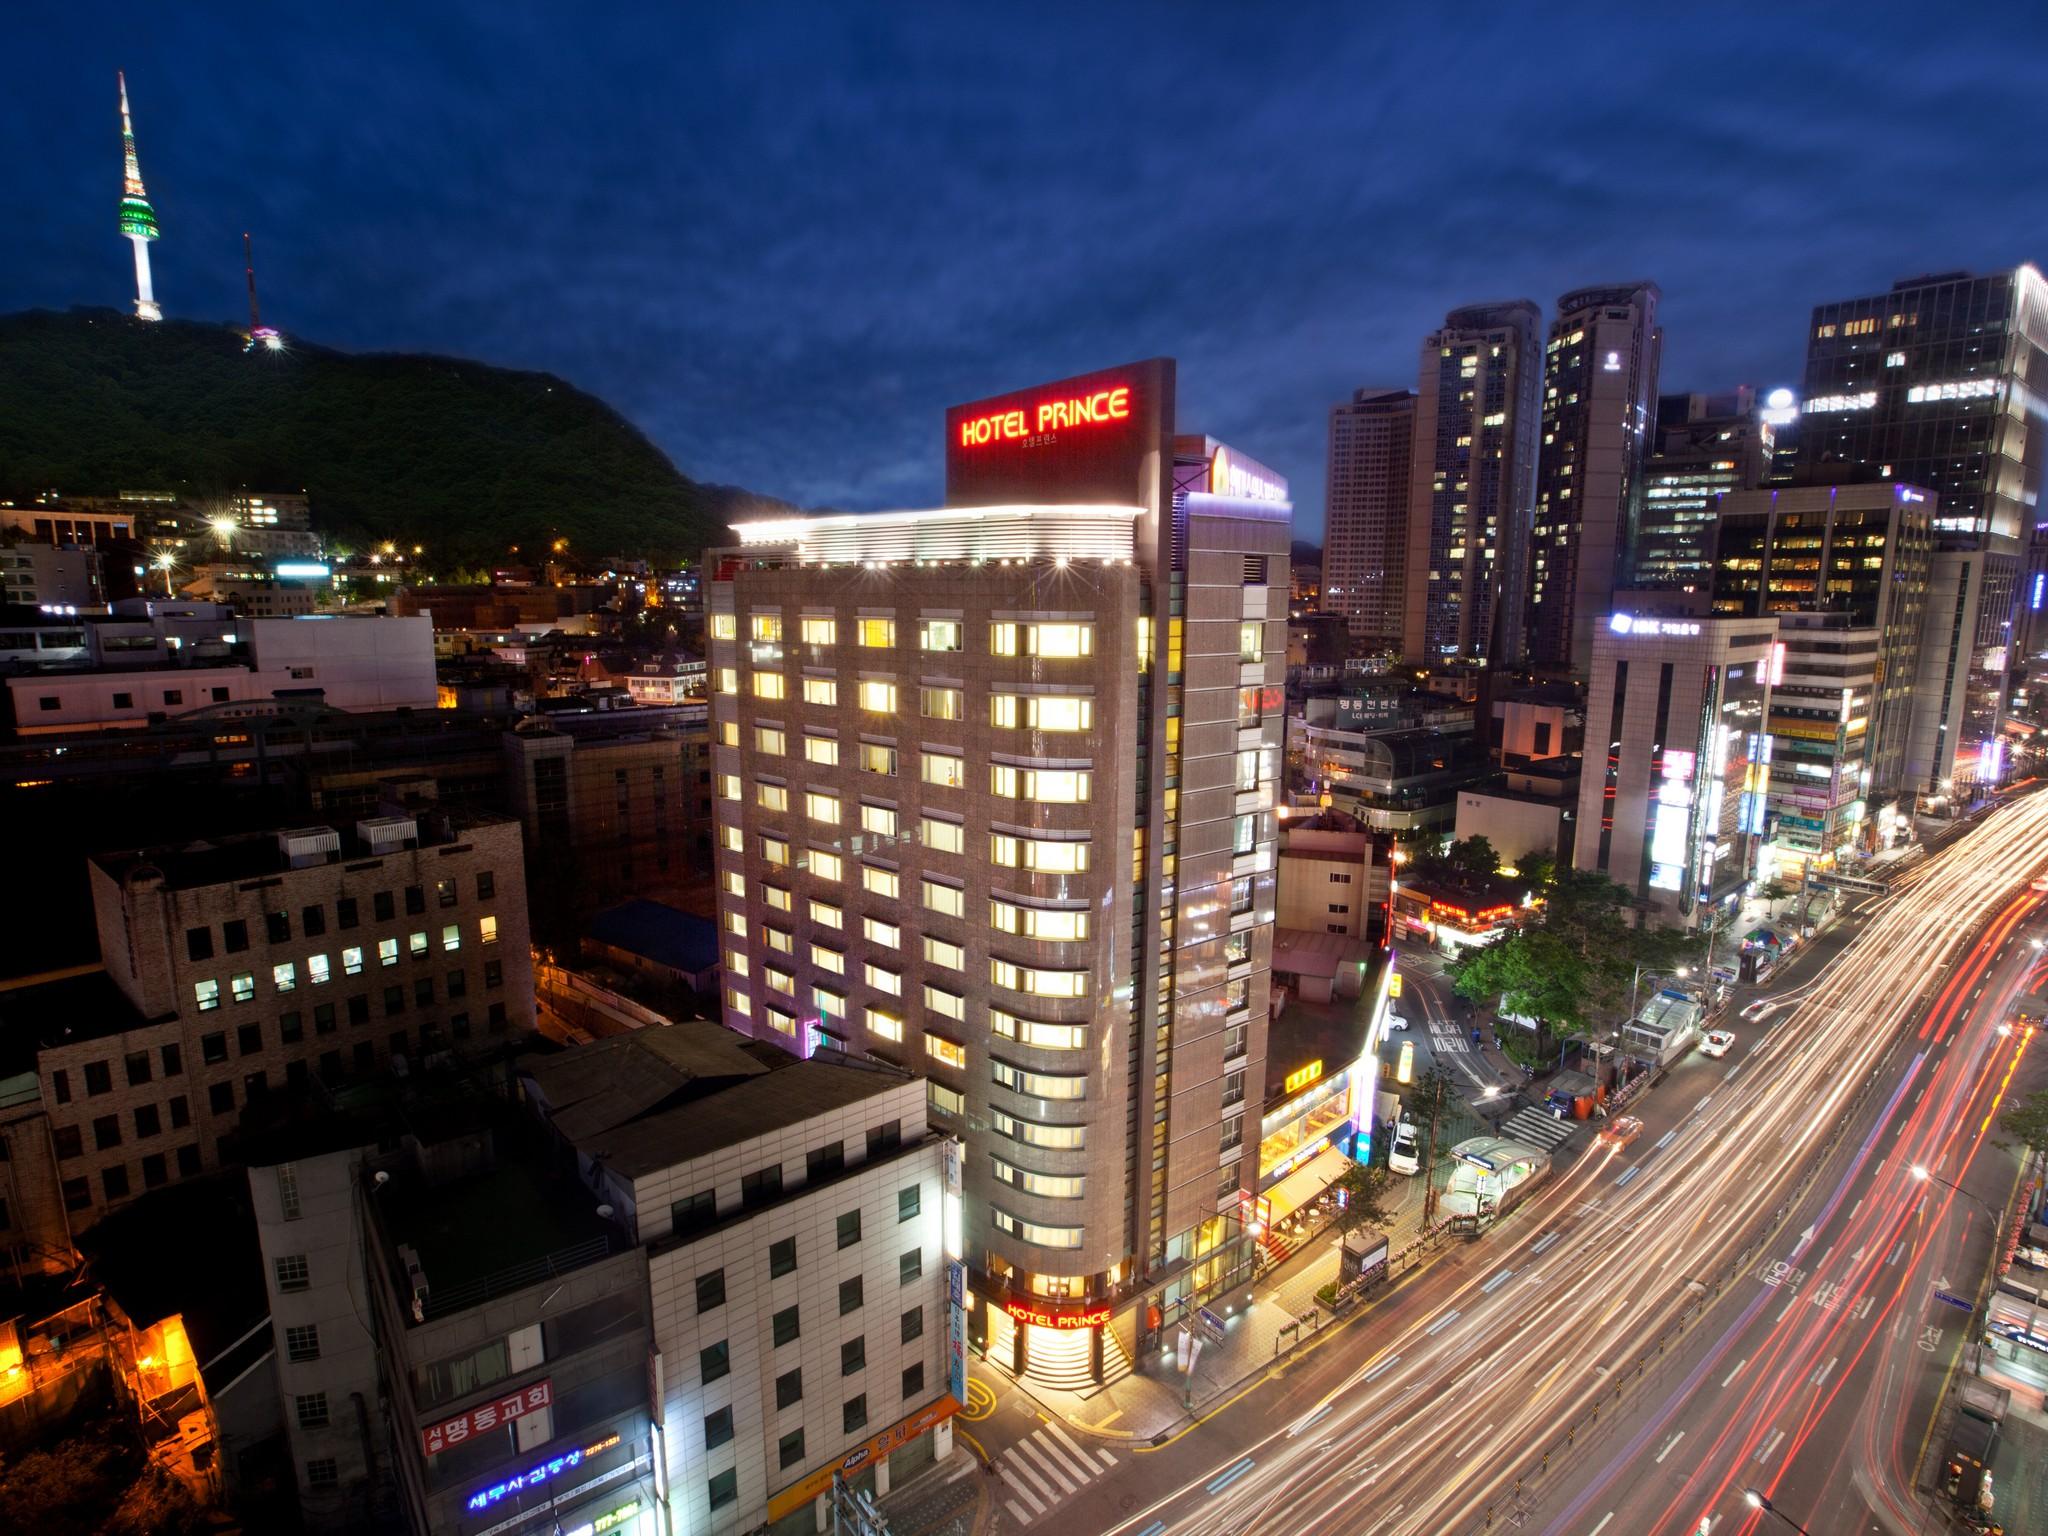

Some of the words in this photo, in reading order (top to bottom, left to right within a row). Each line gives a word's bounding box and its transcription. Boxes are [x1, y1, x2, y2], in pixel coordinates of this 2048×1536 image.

[962, 410, 1029, 446] HOTEL
[1038, 388, 1129, 433] PRINCE
[1022, 432, 1057, 448] 호텔프린스
[1632, 620, 1660, 634] IBK
[1661, 623, 1700, 635] 기업은행
[1339, 699, 1399, 710] 명동컨벤션
[1008, 1304, 1054, 1327] HOTEL
[1057, 1310, 1111, 1328] PRINCE
[428, 1427, 444, 1452] 서울
[445, 1383, 549, 1443] 명동교회
[844, 1448, 870, 1469] Alpha
[468, 1475, 523, 1509] 세무사
